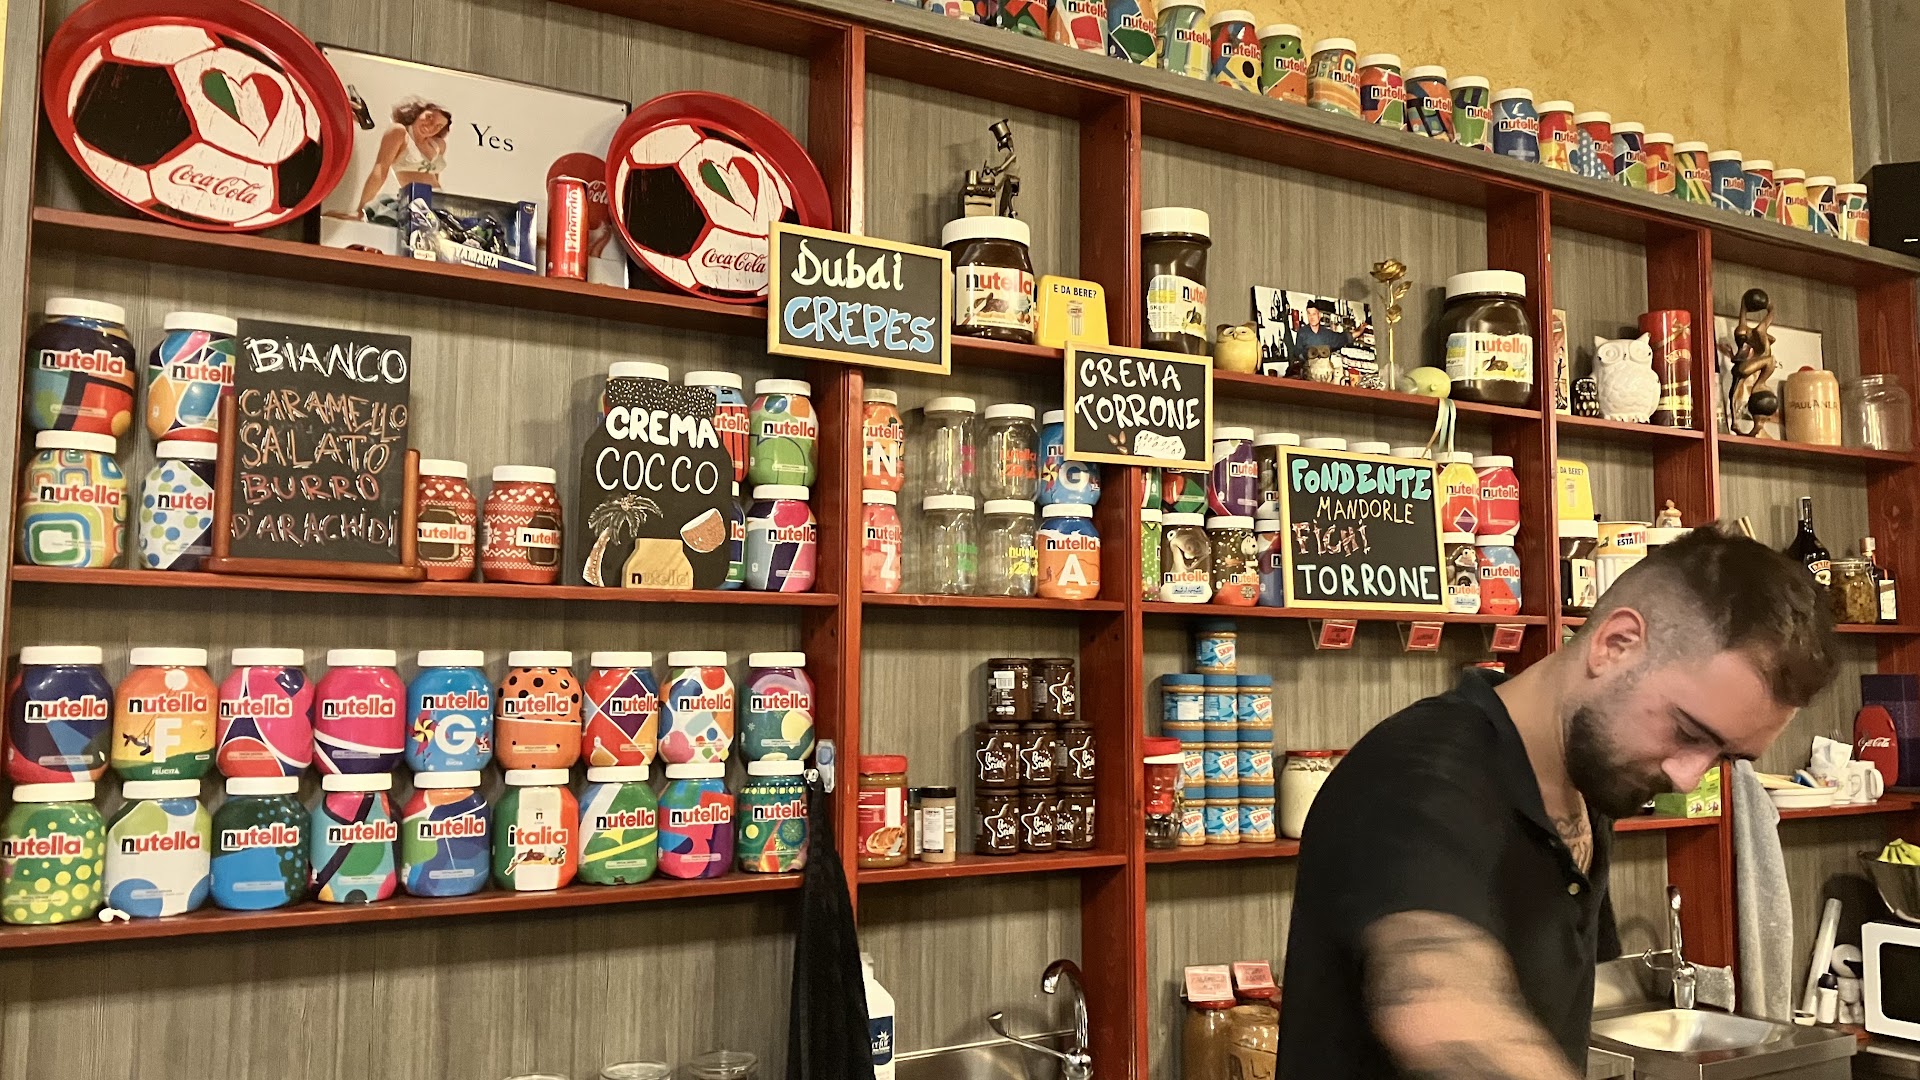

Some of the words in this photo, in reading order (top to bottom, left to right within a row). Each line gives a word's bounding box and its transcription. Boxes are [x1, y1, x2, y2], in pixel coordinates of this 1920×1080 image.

[1425, 98, 1452, 113] nutell
[470, 122, 515, 153] Yes
[168, 164, 262, 206] Coca-Cola
[454, 247, 500, 269] YAMAHA
[701, 247, 767, 275] Coca-Cola
[791, 239, 904, 291] Dubai
[1053, 284, 1059, 293] E
[1061, 285, 1071, 295] DA
[1073, 286, 1097, 299] BERE?
[784, 295, 936, 354] CREPES
[1475, 338, 1527, 355] nutella
[42, 351, 124, 375] nutella
[172, 363, 235, 384] nutell
[1080, 357, 1182, 392] CREMA
[239, 388, 408, 443] CARAMELLO
[1075, 393, 1201, 431] TORRONE
[605, 405, 719, 450] CREMA
[763, 420, 816, 439] nutella
[240, 420, 391, 475] SALATO
[596, 446, 719, 495] COCCO
[1231, 463, 1258, 478] nutell
[41, 484, 120, 505] nutella
[240, 471, 381, 505] BURRO
[1482, 486, 1519, 500] nutella
[157, 490, 214, 511] nutel
[1316, 496, 1415, 525] MANDORLE
[768, 526, 816, 543] nutella
[1047, 537, 1097, 551] nutella
[631, 569, 690, 588] nutella
[1057, 553, 1088, 587] A
[1482, 565, 1520, 579] nutella
[1297, 563, 1439, 601] TORRONE
[28, 697, 107, 719] nutella
[129, 693, 207, 713] nutella
[220, 697, 290, 716] nutella
[324, 697, 393, 716] nutella
[422, 691, 489, 709] nutella
[505, 695, 569, 713] nutella
[679, 693, 731, 711] nutella
[752, 692, 809, 711] nutella
[153, 718, 182, 763] F
[435, 714, 477, 755] G
[596, 810, 654, 830] nutella
[672, 805, 730, 825] nutella
[224, 825, 298, 848] nutella
[329, 821, 397, 843] nutella
[420, 817, 486, 838] nutella
[509, 825, 567, 845] italia
[1, 835, 81, 857] nutella
[122, 831, 200, 854] nutella
